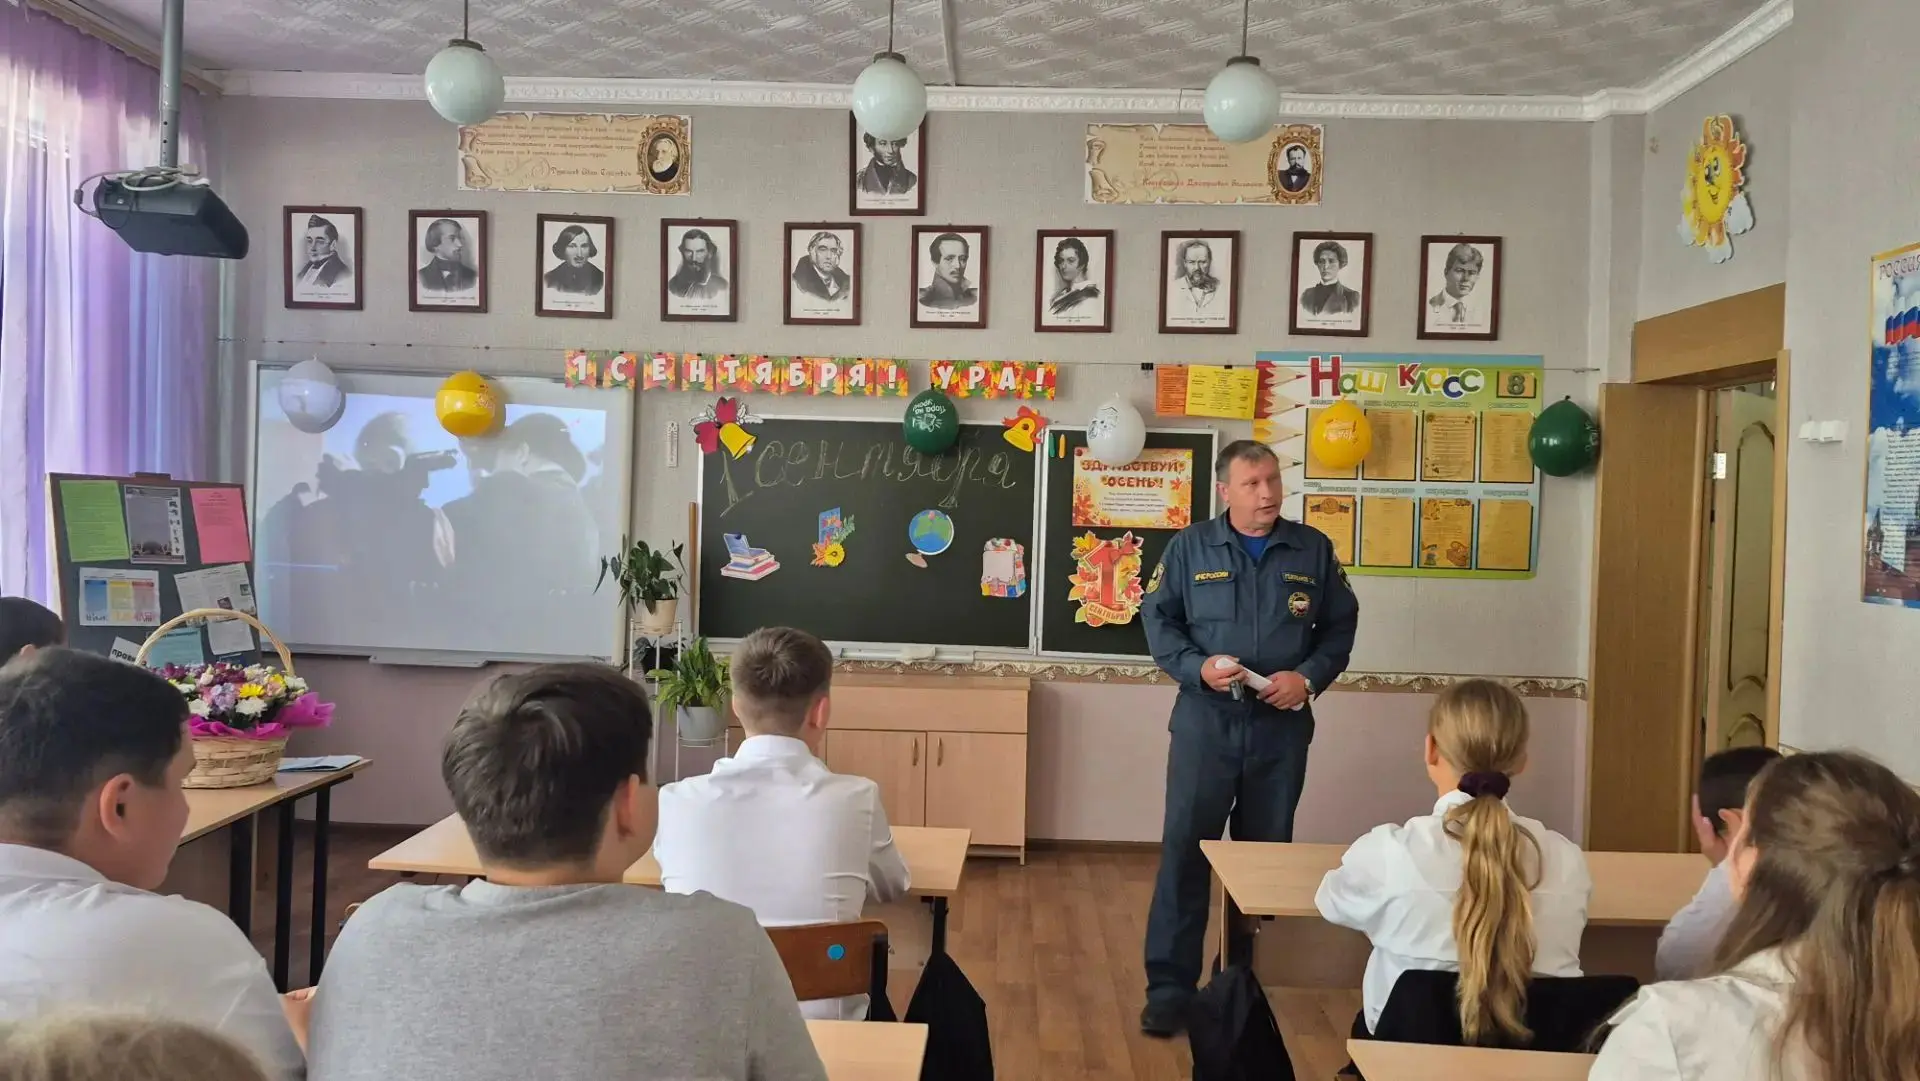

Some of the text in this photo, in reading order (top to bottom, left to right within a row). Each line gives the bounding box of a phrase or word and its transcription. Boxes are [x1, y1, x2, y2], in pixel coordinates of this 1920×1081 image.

[572, 354, 1045, 392] 1 СЕНТЯБРЯ! УРА!
[1506, 371, 1526, 396] 8
[1107, 476, 1163, 489] ОСЕНЬ!
